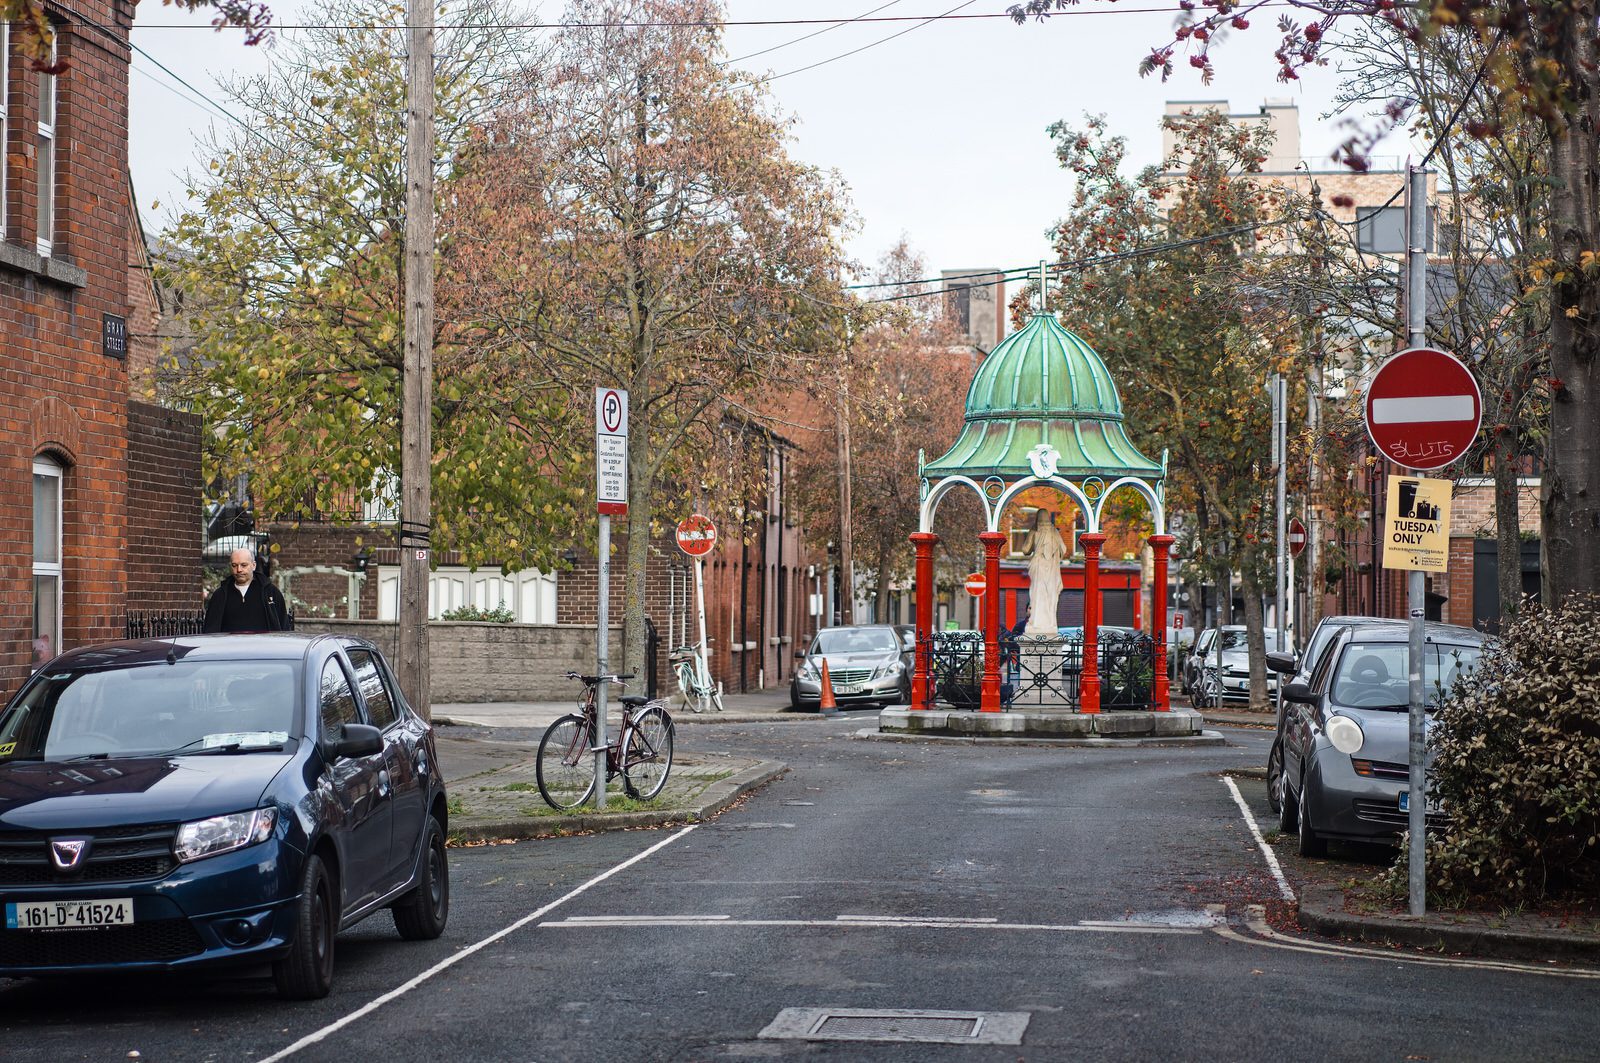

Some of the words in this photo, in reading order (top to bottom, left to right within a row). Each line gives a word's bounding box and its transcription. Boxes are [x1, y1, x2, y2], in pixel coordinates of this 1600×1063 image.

[107, 321, 124, 337] GRAY
[106, 336, 124, 351] STREET
[1393, 519, 1442, 534] TUESDAY
[1392, 532, 1423, 545] ONLY
[25, 904, 125, 926] 161-D-41524
